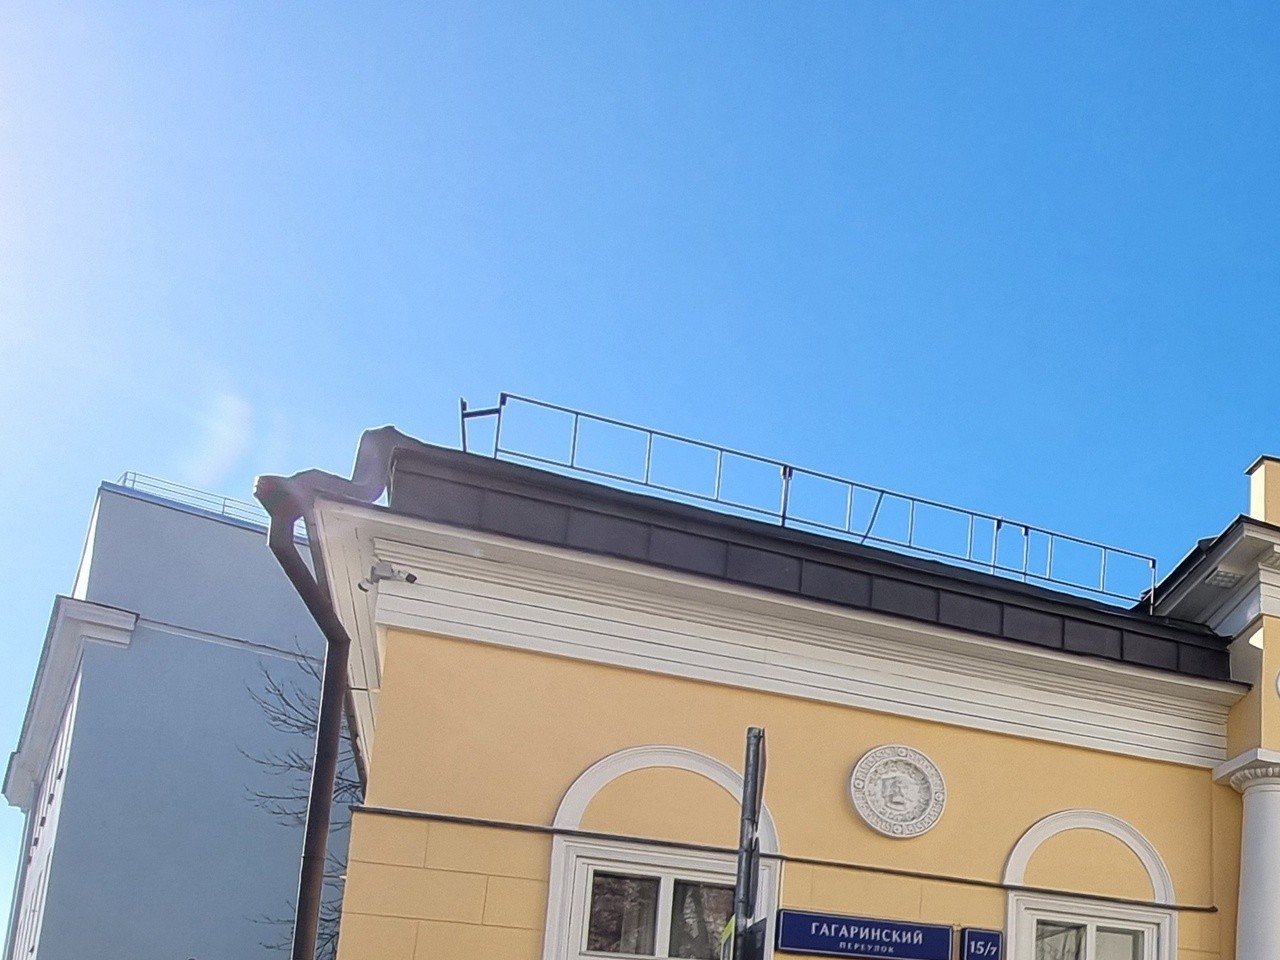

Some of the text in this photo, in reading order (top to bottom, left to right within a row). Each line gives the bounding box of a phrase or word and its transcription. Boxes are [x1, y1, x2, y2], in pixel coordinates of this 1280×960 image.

[811, 922, 923, 944] ГАГАРИНСКИЙ
[839, 941, 895, 953] ПЕРЕУЛОК
[970, 940, 998, 957] 15/7
